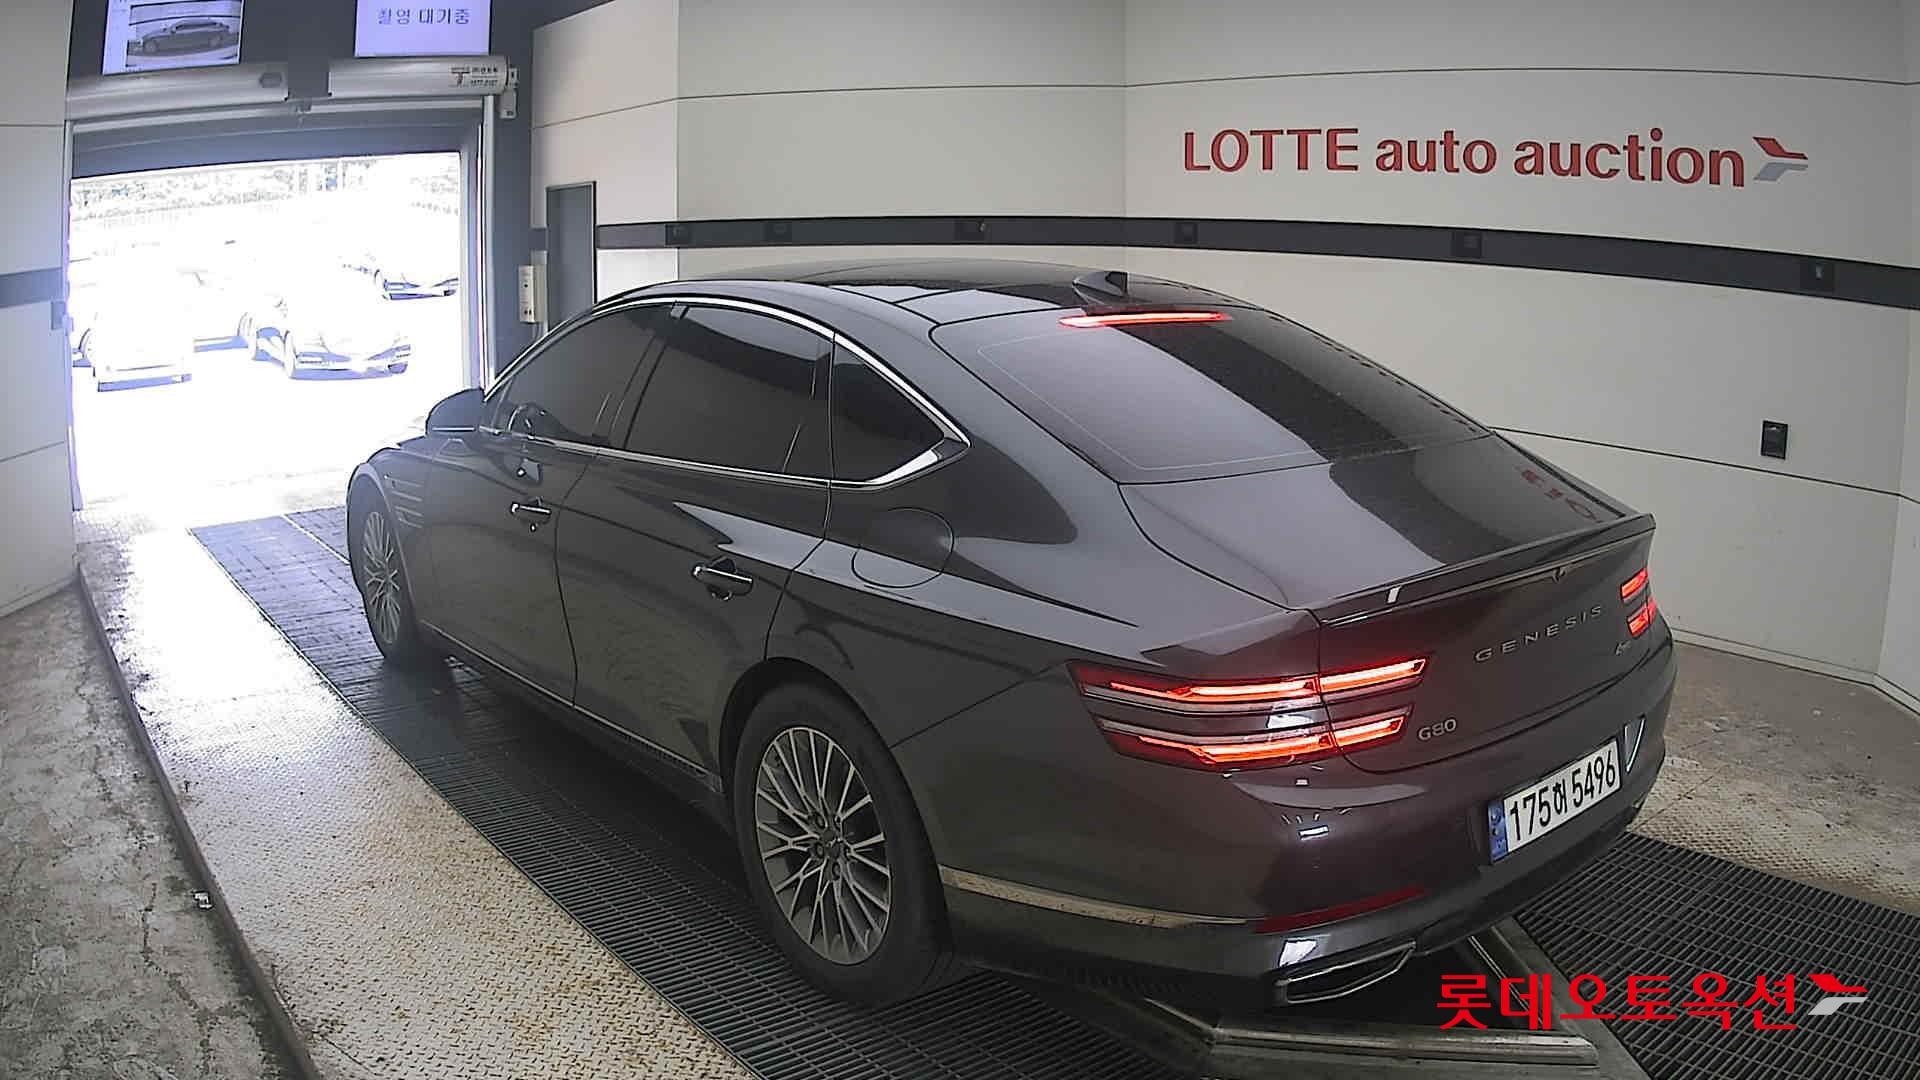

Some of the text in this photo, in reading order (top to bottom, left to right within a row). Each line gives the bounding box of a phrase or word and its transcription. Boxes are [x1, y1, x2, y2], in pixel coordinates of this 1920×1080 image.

[419, 8, 470, 25] 대기중
[1184, 128, 1745, 188] LOTTE auto auction
[1475, 606, 1602, 662] GENESIS
[1418, 718, 1457, 741] G80
[1571, 749, 1616, 808] 5496
